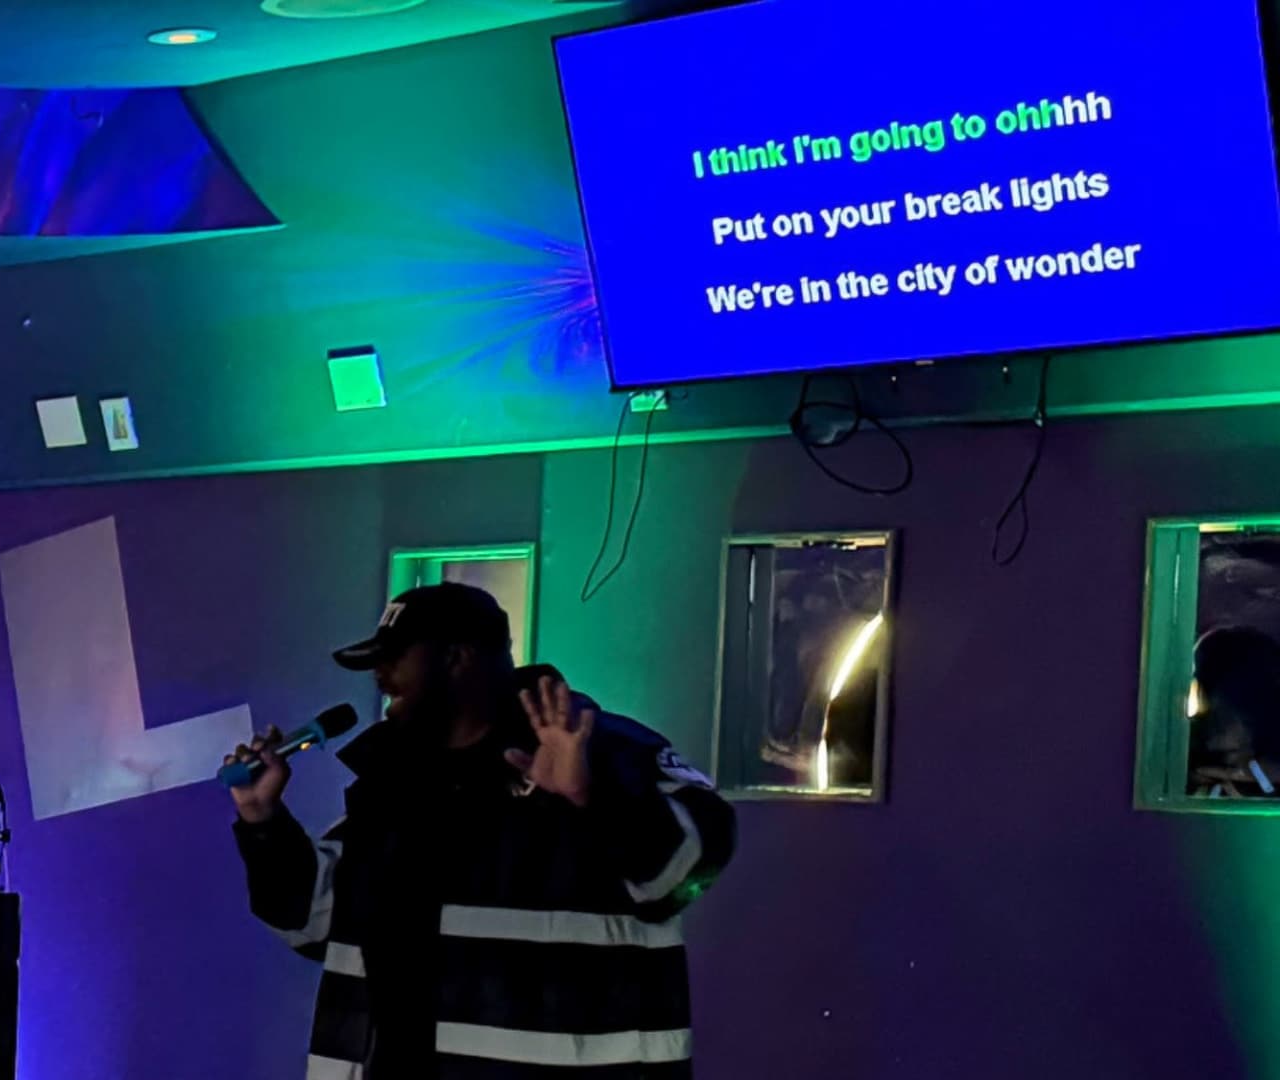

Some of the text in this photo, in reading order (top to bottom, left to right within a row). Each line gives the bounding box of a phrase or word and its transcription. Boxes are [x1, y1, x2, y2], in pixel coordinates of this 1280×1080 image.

[692, 91, 1112, 179] I think I'm going to ohhhh
[711, 170, 1110, 245] Put on your break lights
[705, 242, 1142, 314] We're in the city of wonder
